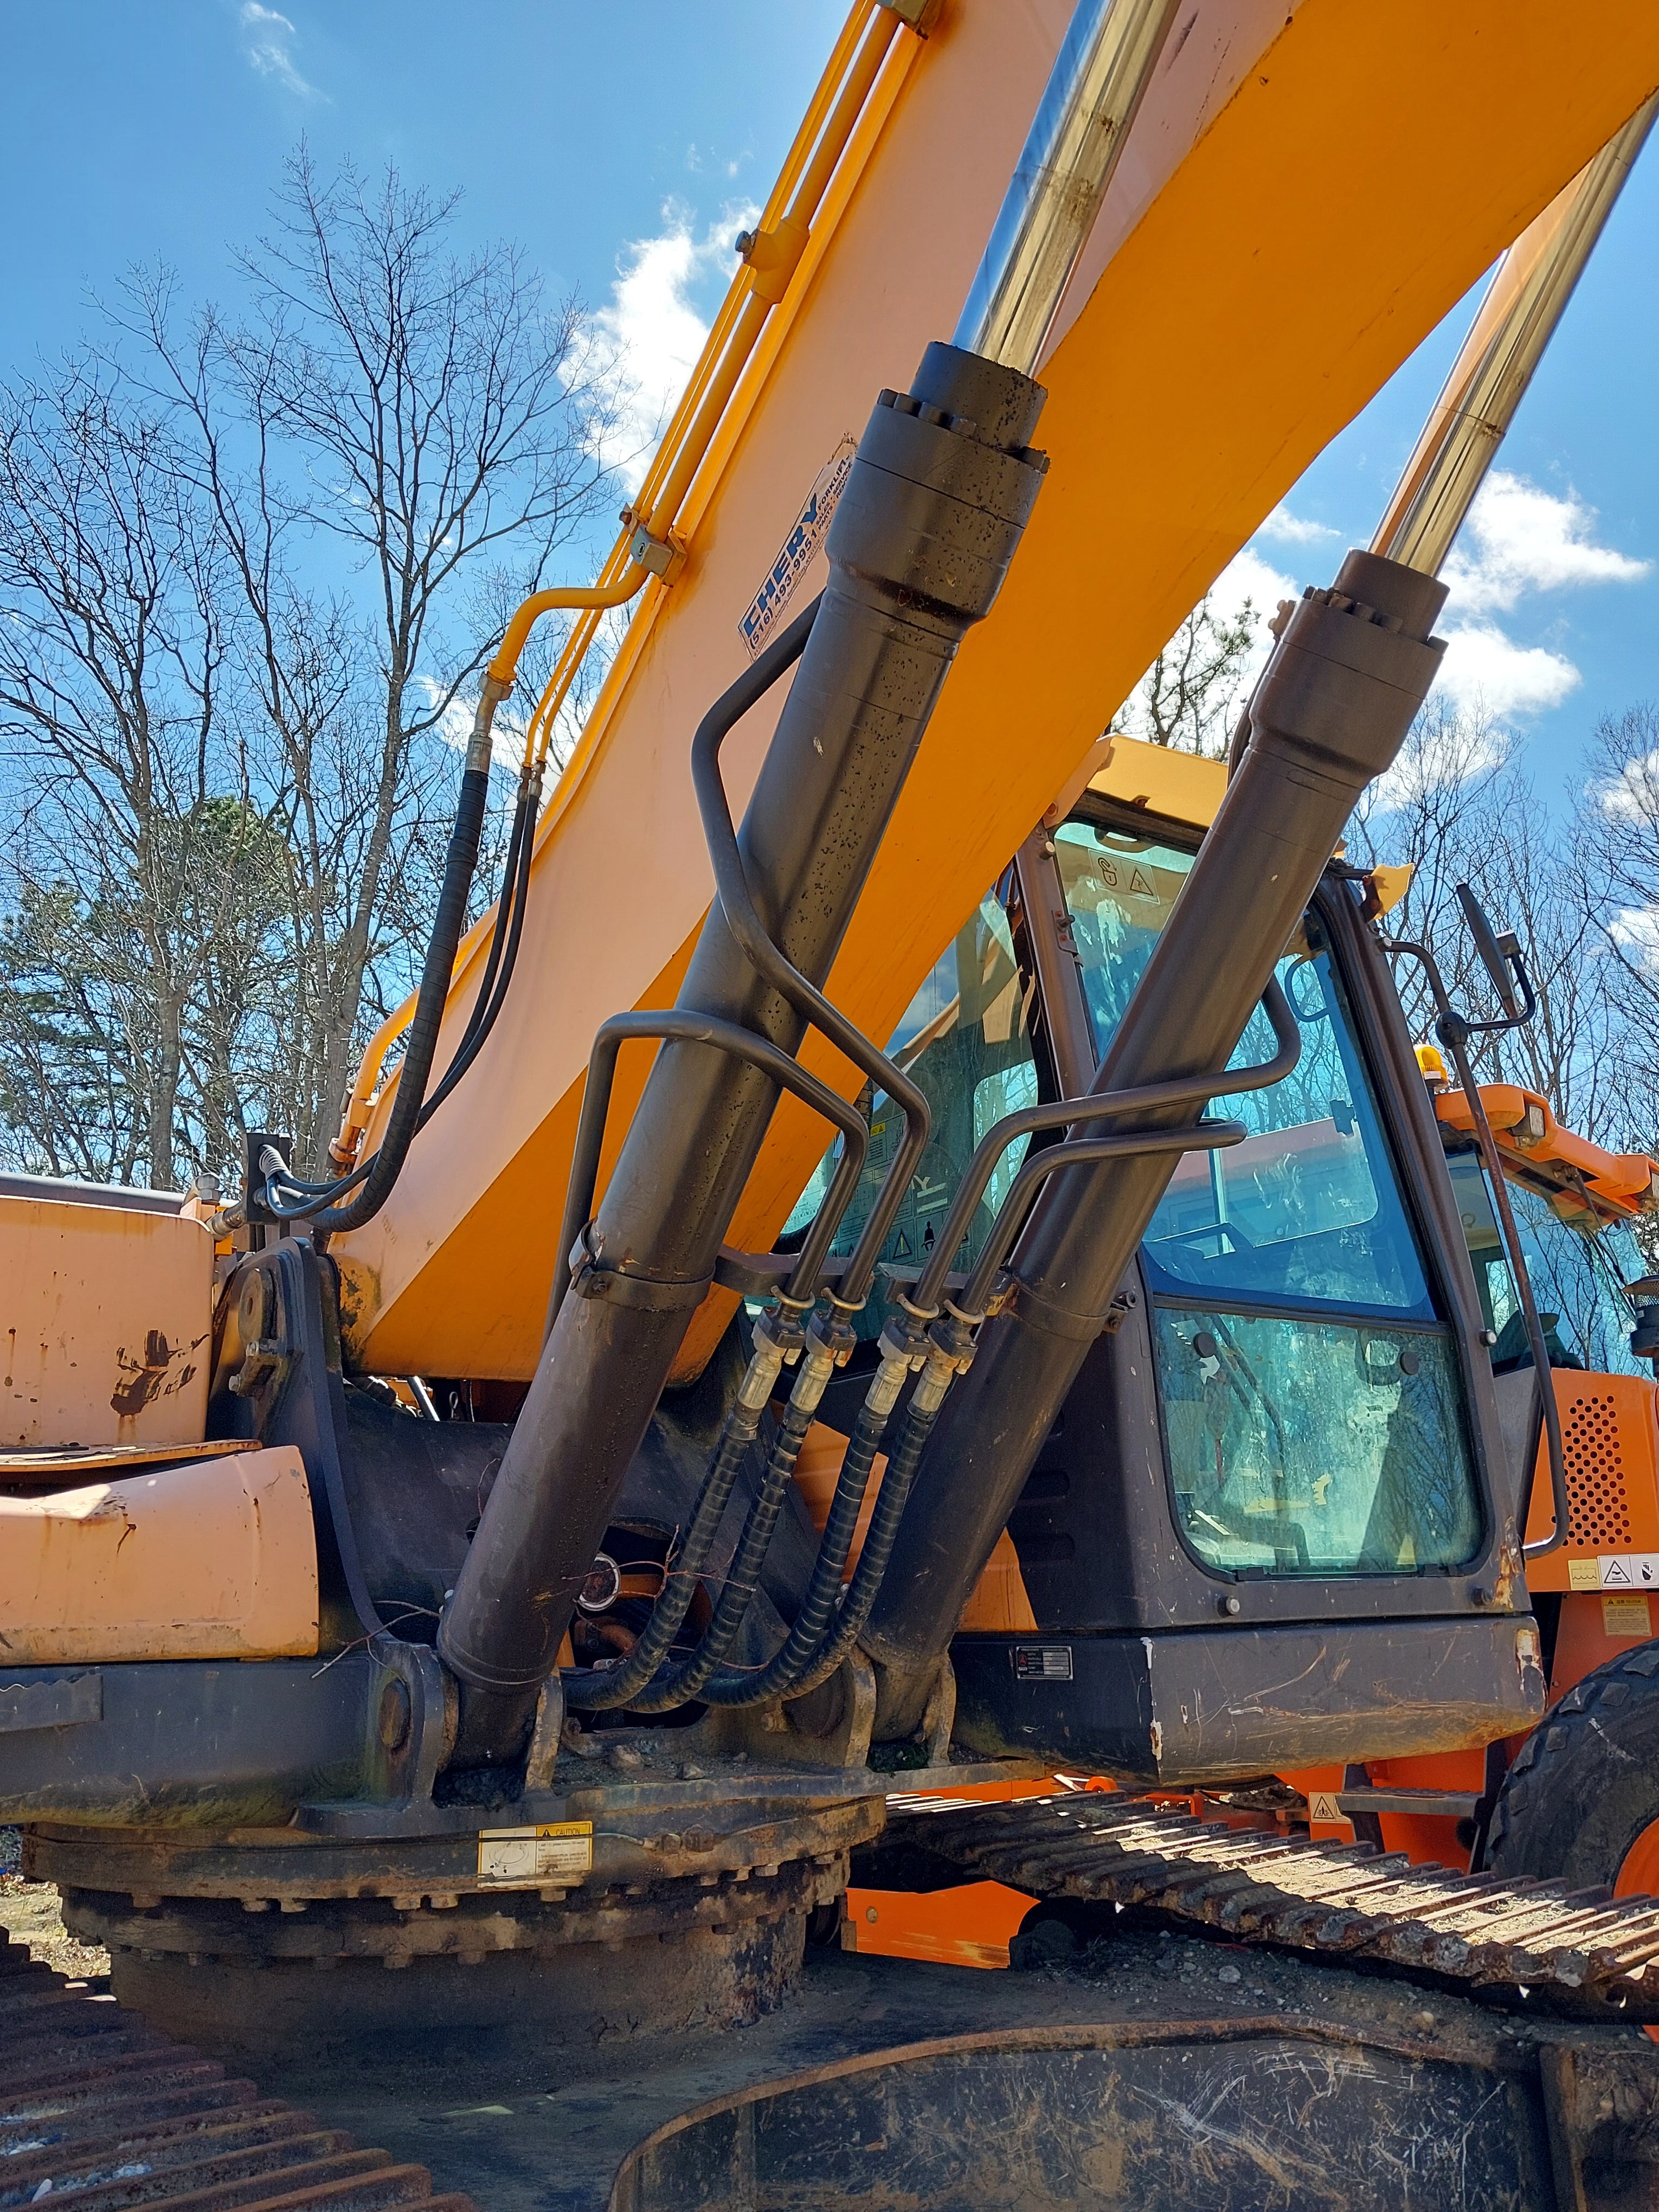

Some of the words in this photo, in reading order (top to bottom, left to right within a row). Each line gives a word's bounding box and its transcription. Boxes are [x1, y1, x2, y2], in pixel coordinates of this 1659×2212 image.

[816, 501, 830, 525] SALES
[833, 461, 852, 496] SERVICE
[818, 505, 833, 530] PARTS
[744, 492, 818, 638] CHERY
[787, 577, 799, 597] Garden
[750, 607, 773, 650] (516)
[775, 529, 817, 605] 493-9951
[556, 1828, 580, 1836] CAUTION
